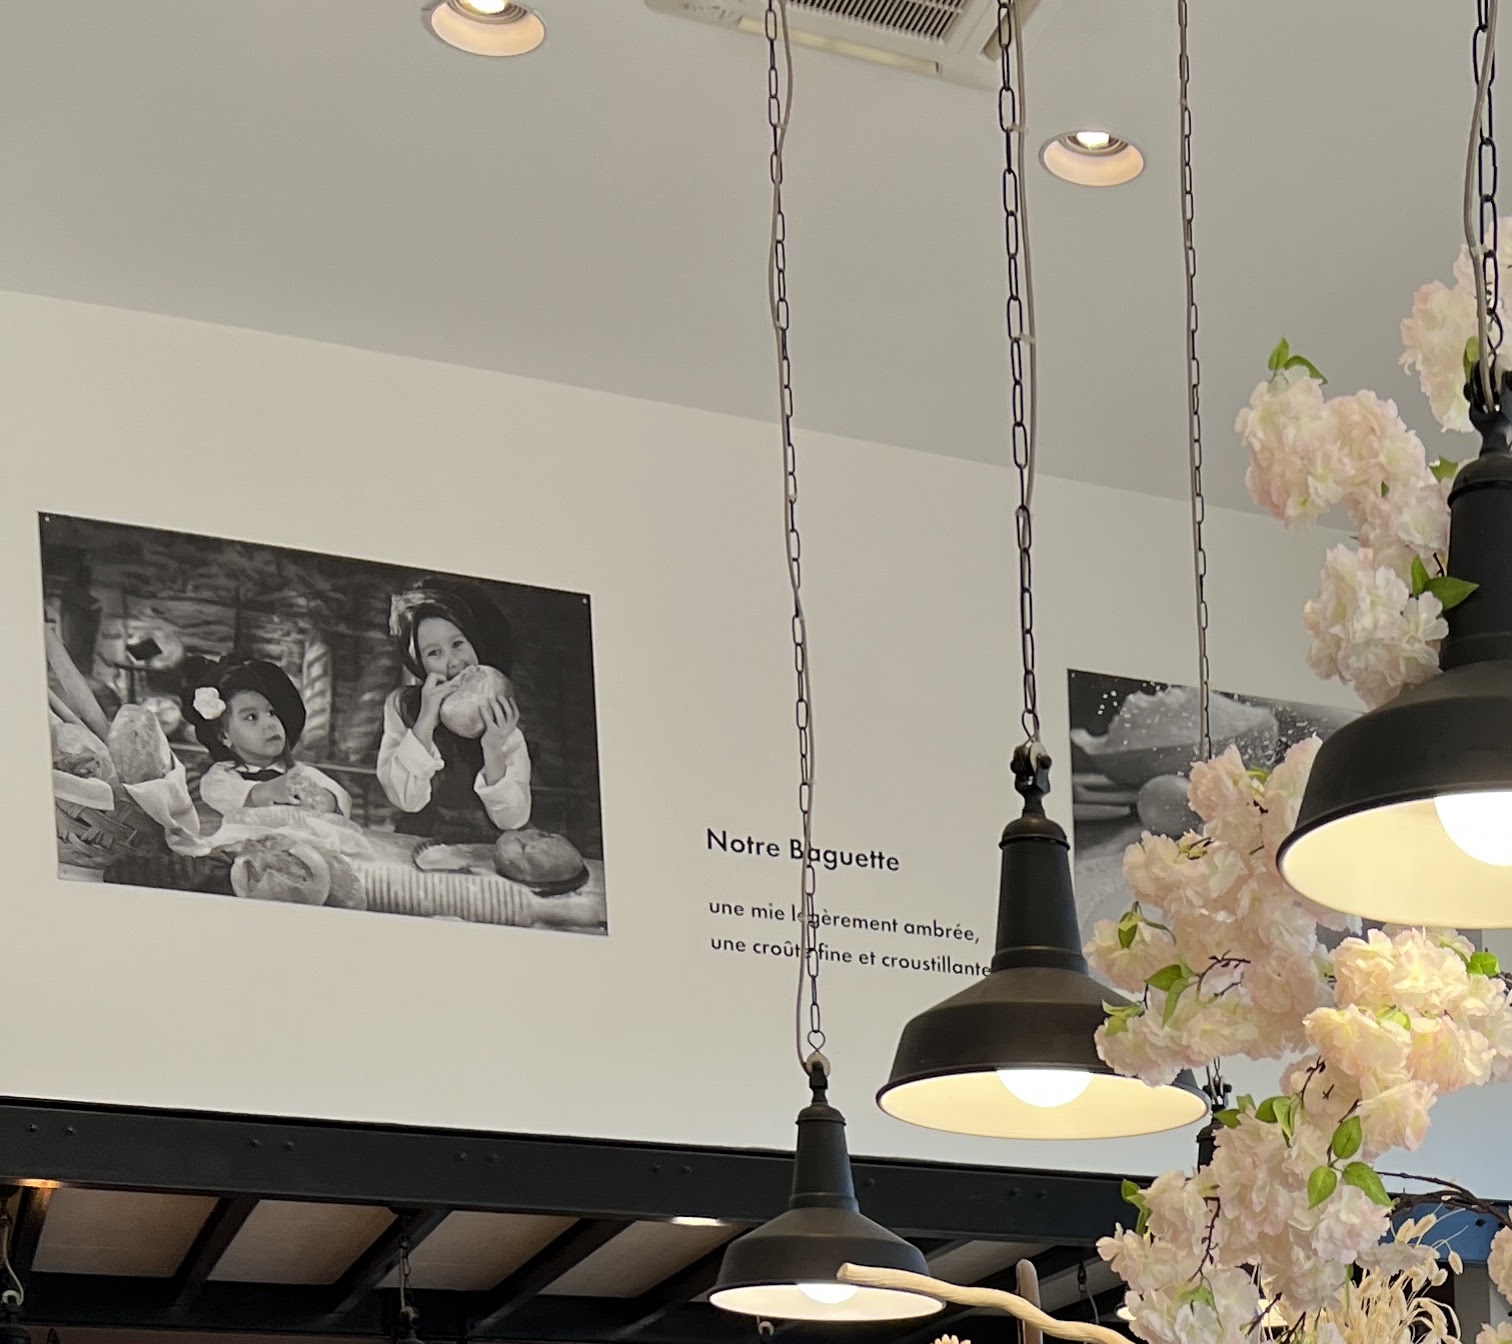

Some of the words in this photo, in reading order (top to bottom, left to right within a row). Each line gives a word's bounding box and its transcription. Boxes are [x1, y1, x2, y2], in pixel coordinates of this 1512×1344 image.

[706, 828, 780, 858] Notre
[789, 838, 900, 870] Baguette
[709, 901, 745, 917] une
[751, 903, 785, 921] mie
[903, 921, 980, 944] ambrée,
[711, 938, 746, 953] une
[752, 940, 812, 960] croût
[818, 941, 852, 963] fine
[859, 951, 876, 966] et
